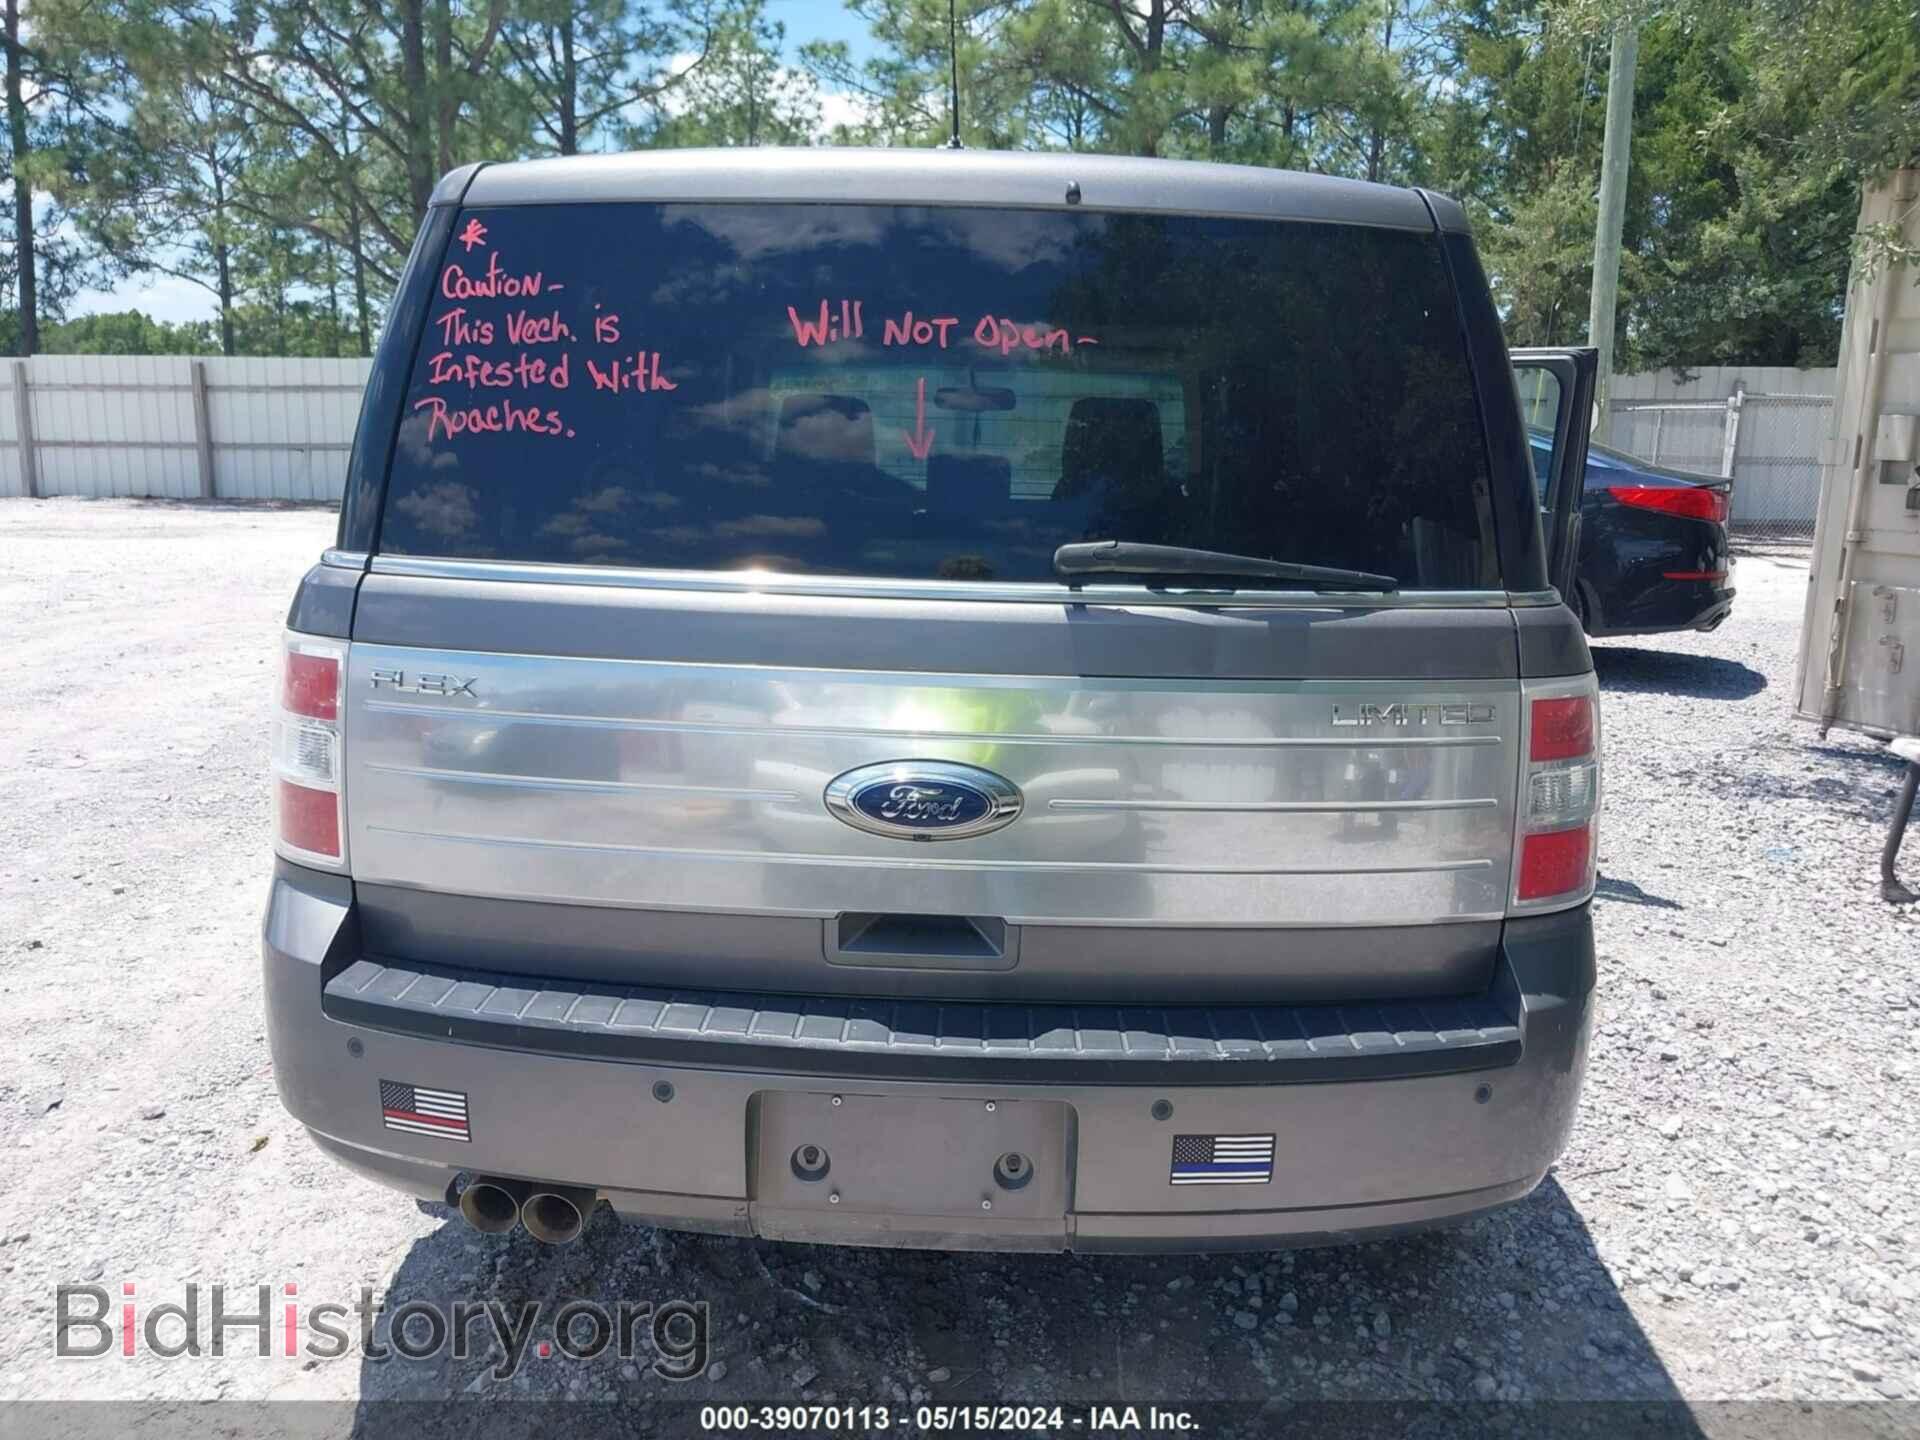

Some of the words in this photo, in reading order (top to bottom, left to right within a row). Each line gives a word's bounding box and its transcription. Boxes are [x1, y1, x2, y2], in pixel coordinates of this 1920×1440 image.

[436, 307, 494, 346] This
[594, 303, 620, 343] is
[787, 299, 863, 347] Will
[883, 311, 959, 349] NOT
[428, 352, 569, 389] Infested
[414, 397, 576, 442] Roaches.
[369, 668, 479, 698] FLEX
[1331, 703, 1496, 726] LIMITED
[881, 785, 964, 820] Ford
